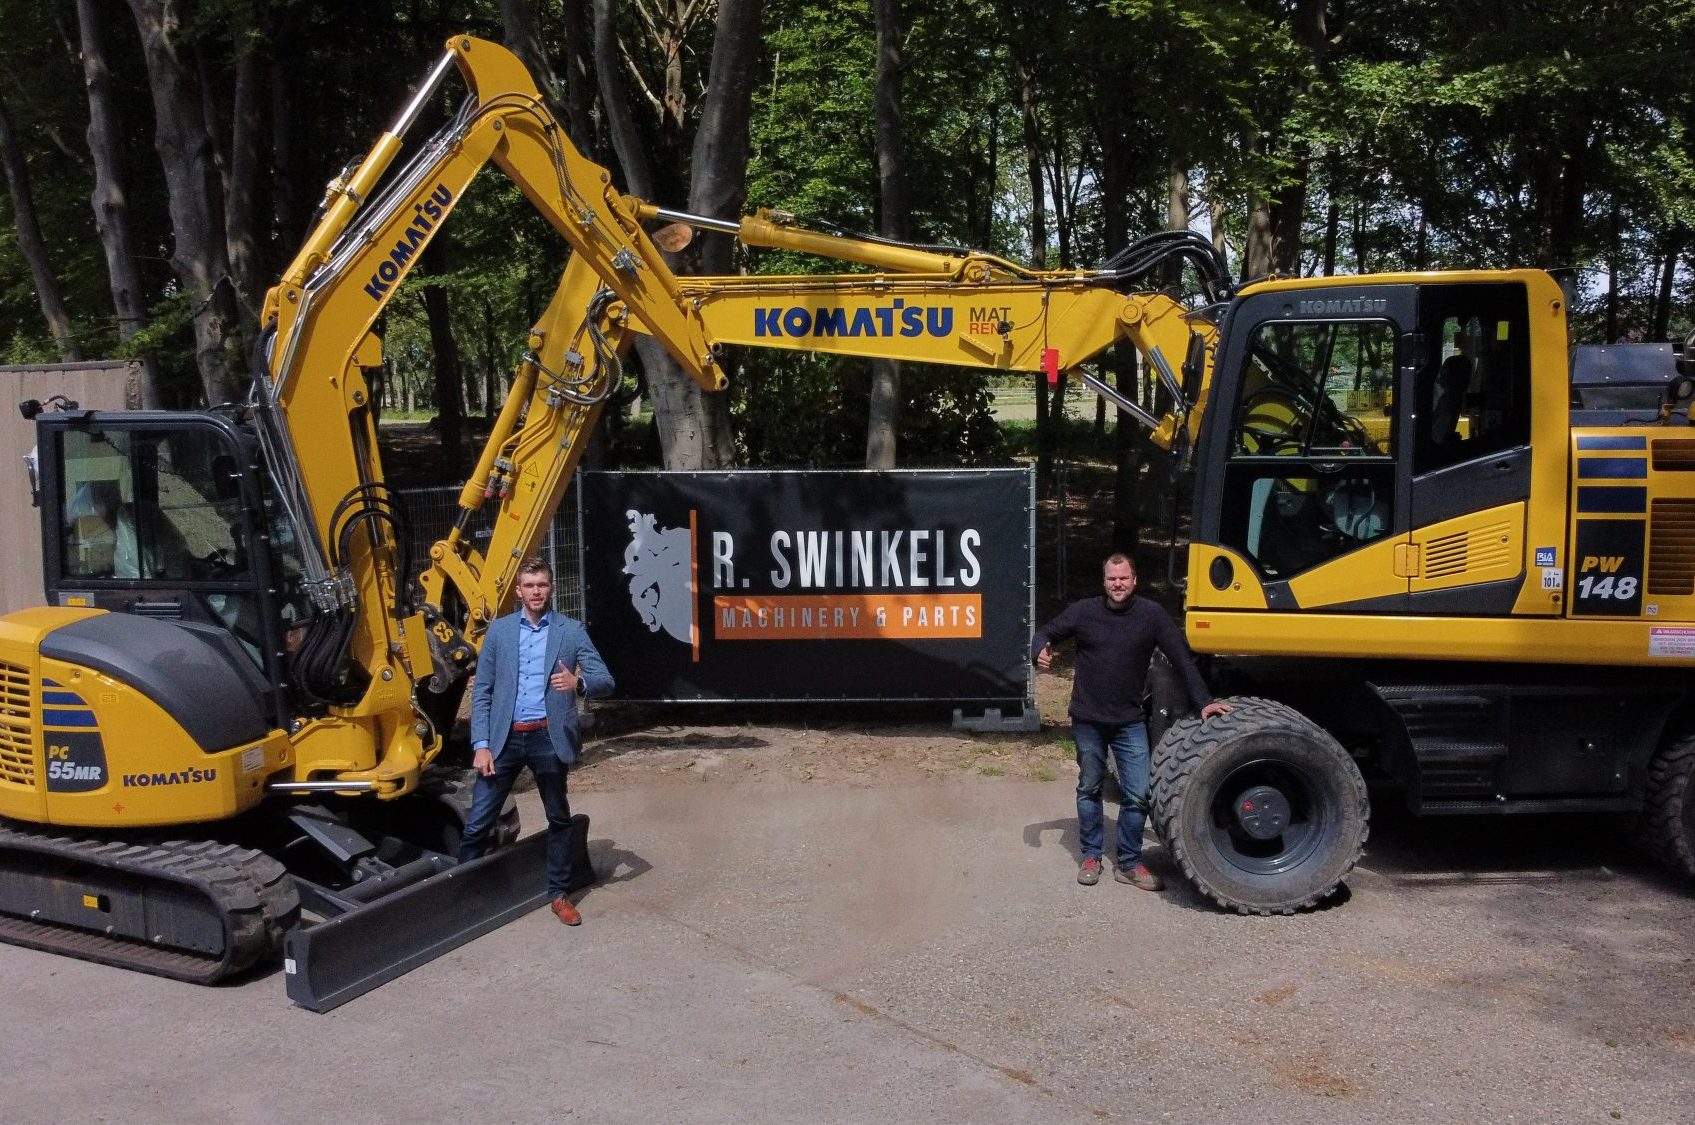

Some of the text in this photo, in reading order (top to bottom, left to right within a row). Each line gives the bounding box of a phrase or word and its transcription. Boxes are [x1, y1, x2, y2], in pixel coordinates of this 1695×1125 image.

[364, 183, 453, 302] KOMATSU
[970, 307, 1011, 322] MAT
[1300, 296, 1387, 314] KOMATSU
[754, 298, 954, 337] KOMATSU
[969, 323, 1004, 335] REN
[713, 529, 981, 588] R. SWINKELS
[1580, 556, 1625, 572] PW
[1578, 576, 1638, 600] 148
[722, 605, 976, 628] MACHINERY & PARTS
[48, 745, 70, 759] PC
[48, 761, 102, 780] 55MR
[123, 767, 217, 787] KOMATSU
